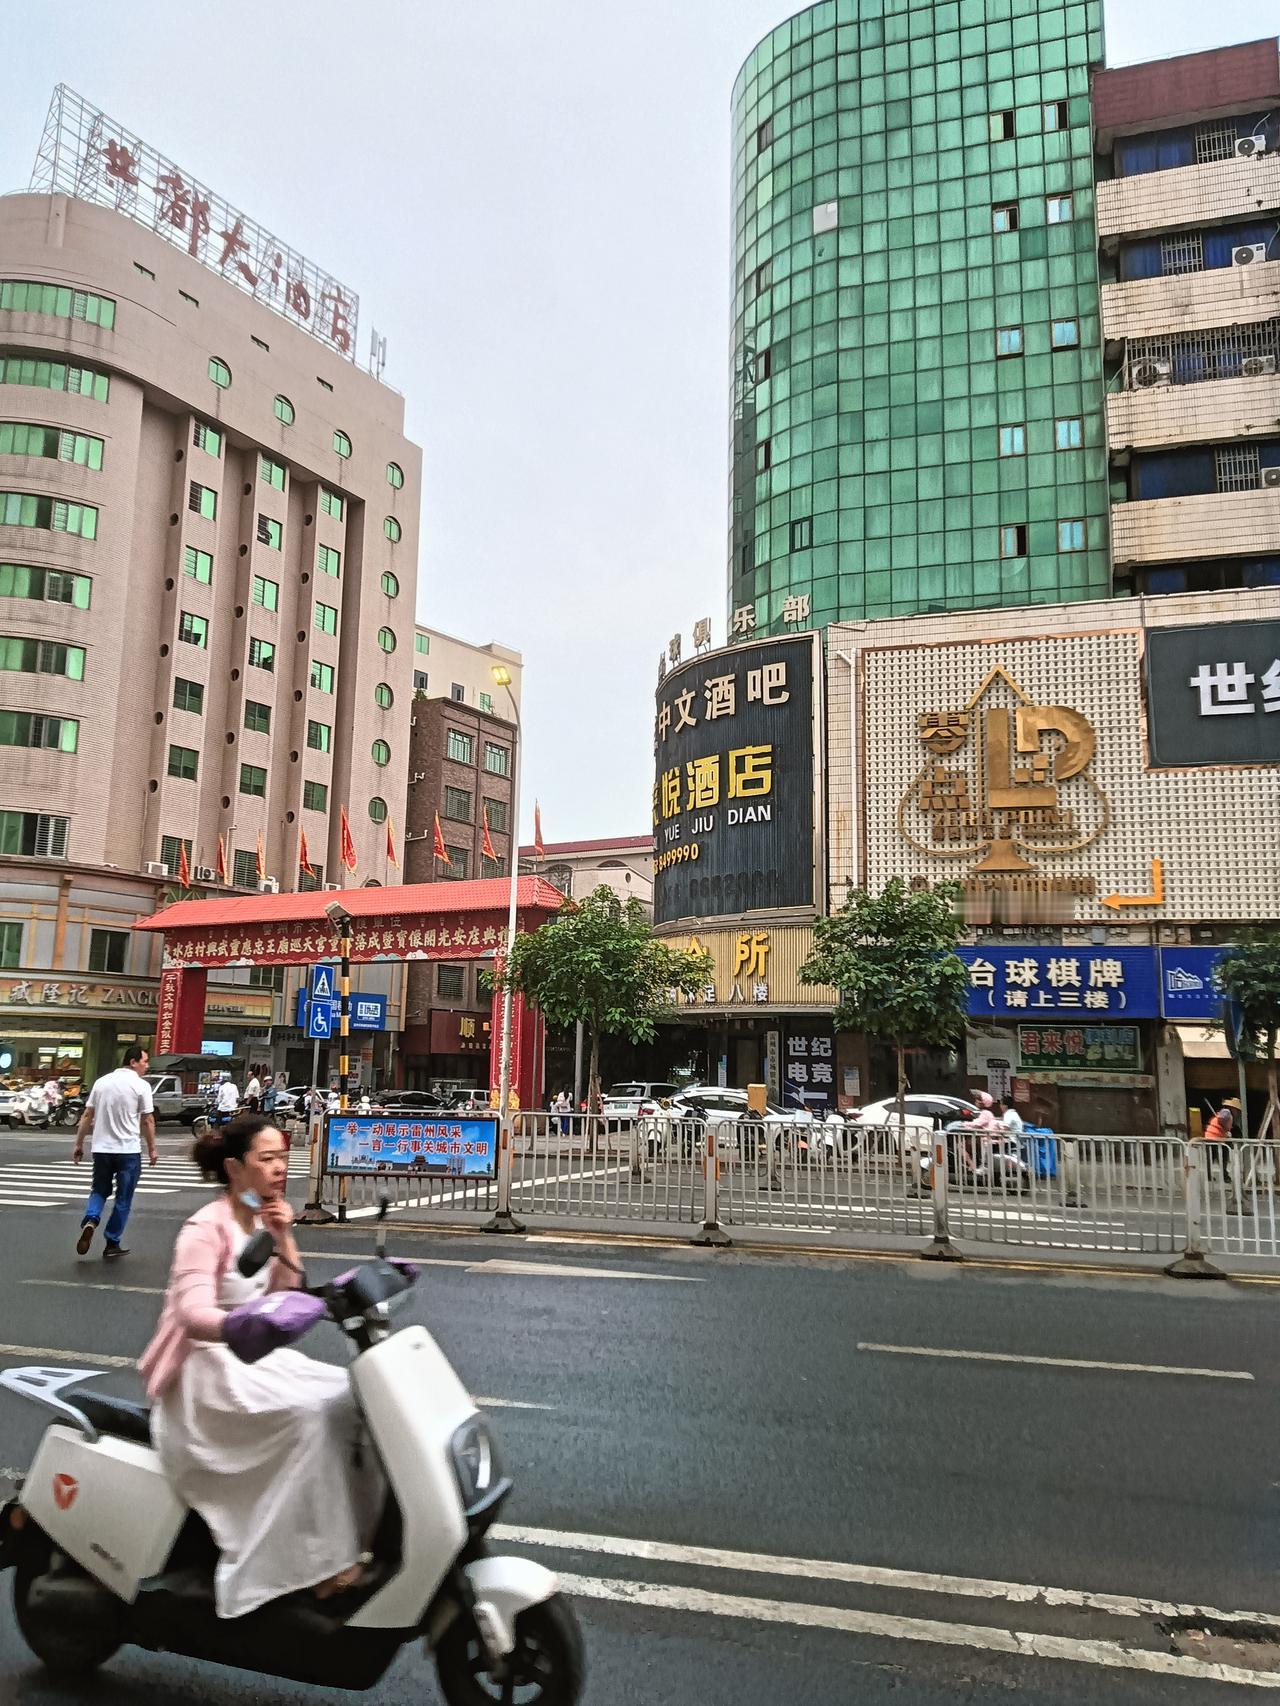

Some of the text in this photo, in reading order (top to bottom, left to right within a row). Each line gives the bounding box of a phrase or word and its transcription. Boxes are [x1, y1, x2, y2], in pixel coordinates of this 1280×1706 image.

[664, 804, 772, 844] YUE JIU DIAN
[967, 957, 1125, 988] 台球棋牌
[787, 1036, 833, 1057] 世纪
[787, 1062, 833, 1083] 电竞
[333, 1123, 463, 1139] 一举一动展示雷州风采
